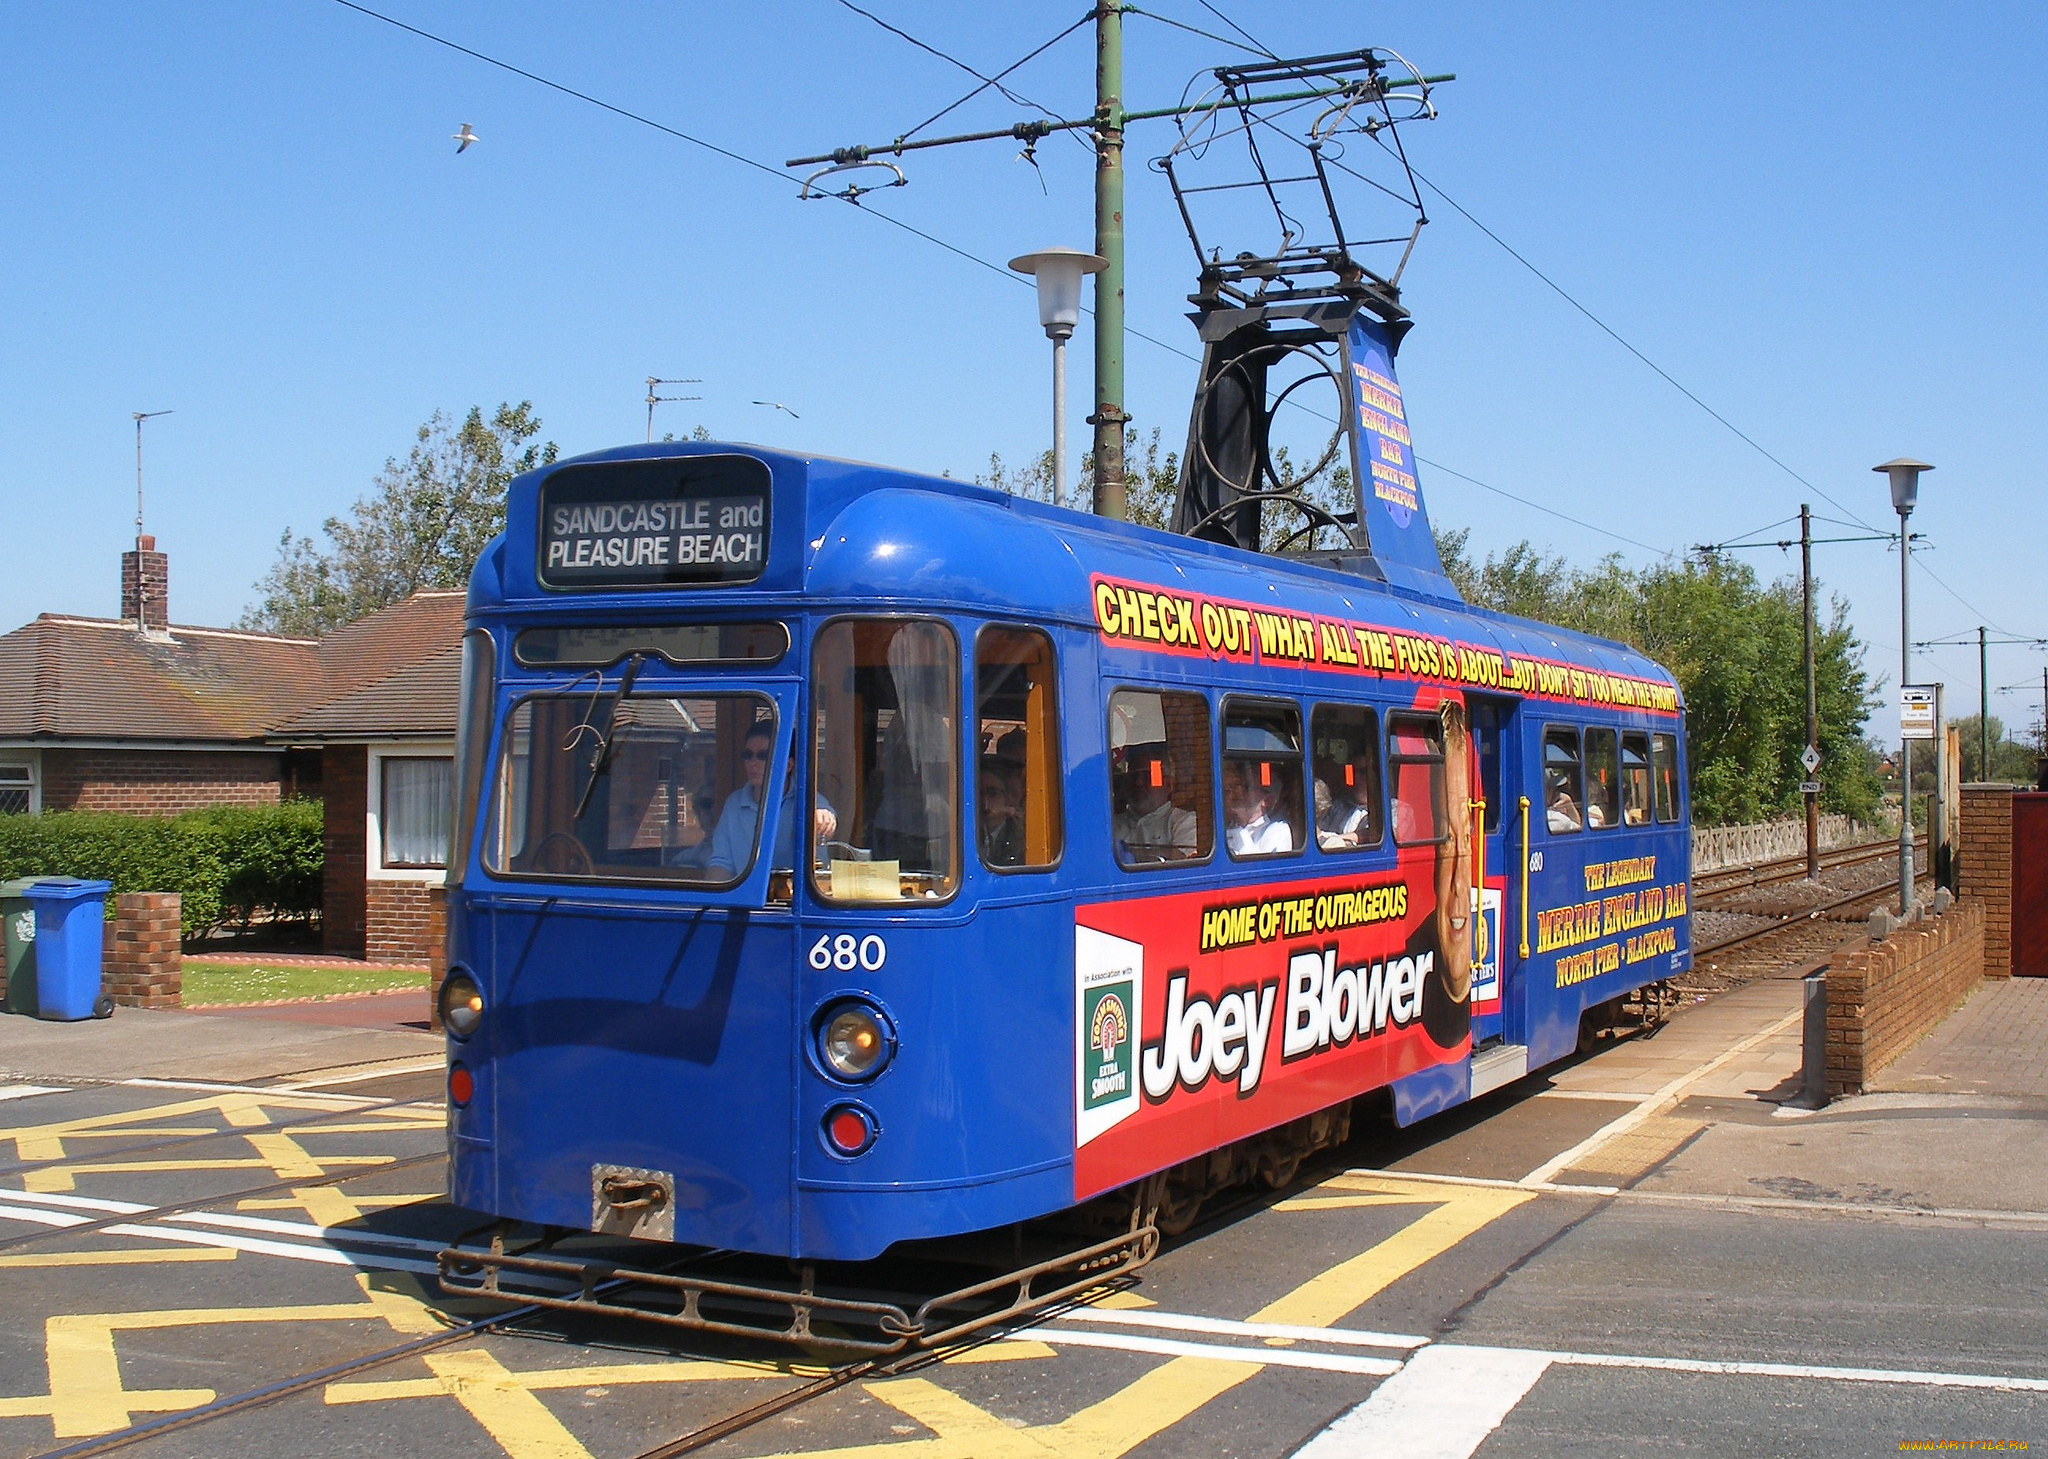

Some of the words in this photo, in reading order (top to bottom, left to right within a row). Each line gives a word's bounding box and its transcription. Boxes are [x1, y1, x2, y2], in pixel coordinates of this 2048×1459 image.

[1359, 405, 1411, 446] ENGLAND
[1379, 437, 1403, 467] BAR
[1370, 460, 1397, 484] NORTH
[553, 501, 709, 535] SANDCASTLE
[719, 498, 763, 528] and
[548, 536, 670, 568] PLEASURE
[678, 533, 762, 564] BEACH
[1095, 583, 1199, 645] CHECK
[1202, 602, 1251, 651] OUT
[1254, 612, 1315, 660] WHAT
[1319, 623, 1358, 665] ALL
[1355, 628, 1395, 670] THE
[1396, 636, 1440, 675] FUSS
[1442, 643, 1458, 678] IS
[1535, 662, 1570, 696] DON'T
[1570, 668, 1589, 699] SIT
[1587, 672, 1611, 703] TOO
[1609, 676, 1636, 706] NEAR
[1631, 680, 1652, 709] THE
[1806, 754, 1814, 763] 4
[1529, 851, 1544, 873] 680
[1584, 863, 1605, 892] THE
[1605, 855, 1657, 888] LEGENDARY
[1201, 905, 1257, 949] HOME
[1258, 909, 1283, 939] OF
[1282, 899, 1314, 935] THE
[1315, 884, 1409, 930] OUTRAGEOUS
[1537, 900, 1600, 954] MERRIE
[1602, 886, 1664, 936] ENGLAND
[1664, 882, 1687, 920] BAR
[808, 933, 887, 972] 680
[1555, 950, 1595, 989] NORTH
[1596, 942, 1619, 974] PIER
[1626, 926, 1677, 965] BLACKPOOL
[1091, 969, 1121, 981] Association
[1142, 976, 1276, 1097] Joey
[1283, 949, 1434, 1058] Blower
[1091, 1071, 1126, 1100] SMOOTH
[1099, 1061, 1119, 1078] EXTRA
